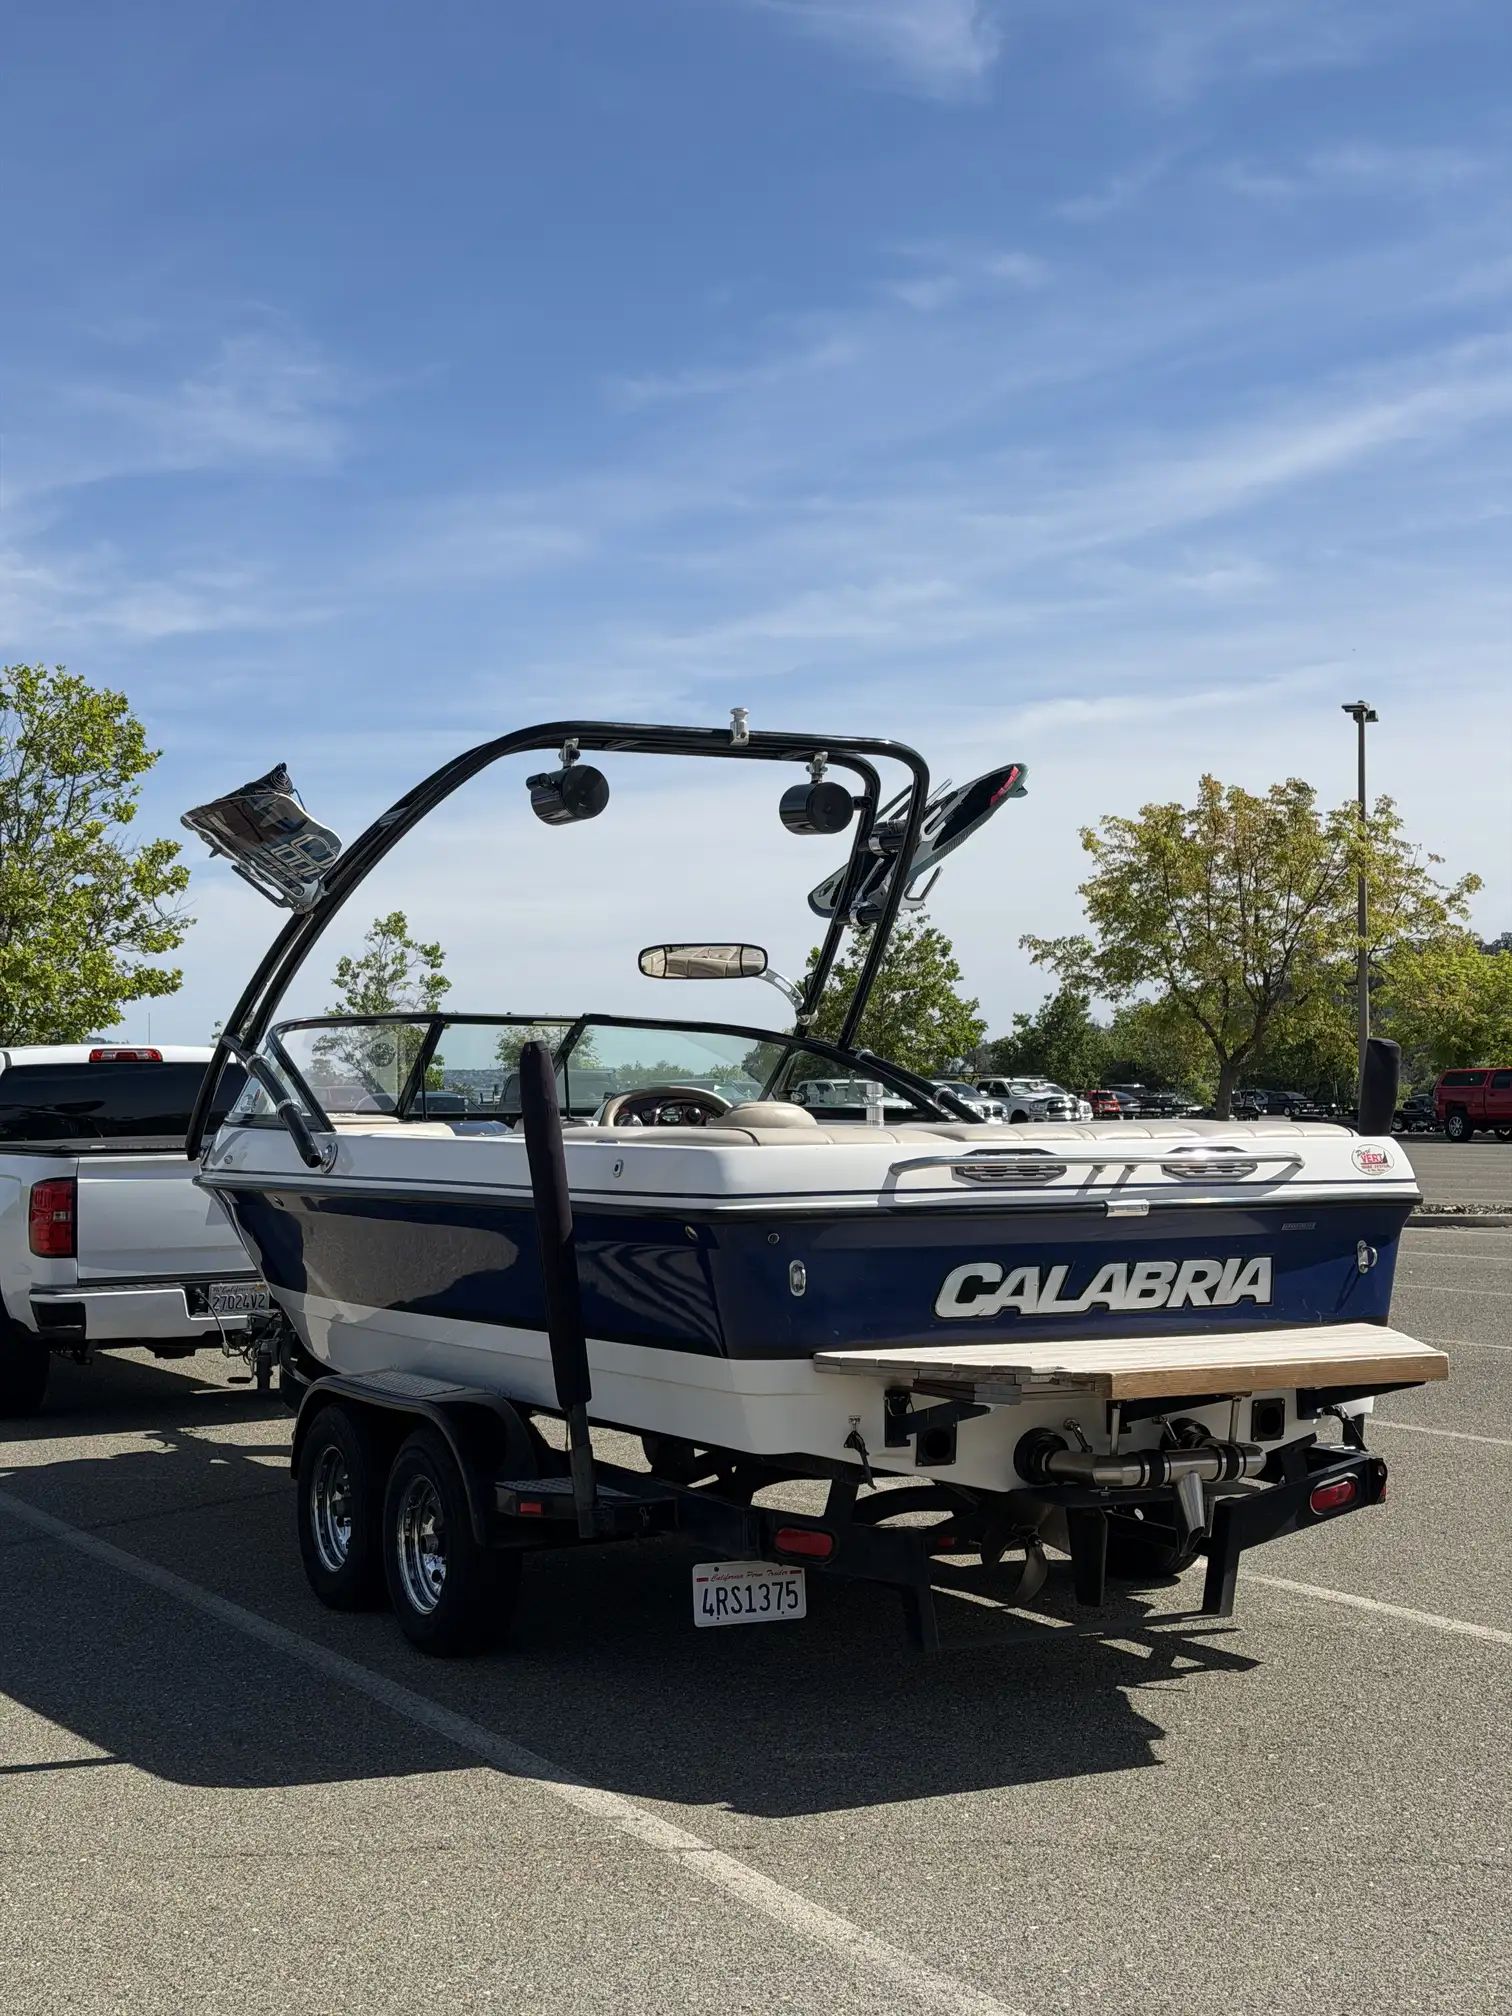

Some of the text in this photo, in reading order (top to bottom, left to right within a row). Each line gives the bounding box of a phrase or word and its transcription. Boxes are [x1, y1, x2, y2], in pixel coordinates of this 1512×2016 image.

[1360, 1153, 1382, 1163] VERT
[935, 1257, 1272, 1318] CALABRIA
[213, 1293, 266, 1311] 27024V2
[702, 1580, 799, 1616] 4RS1375
